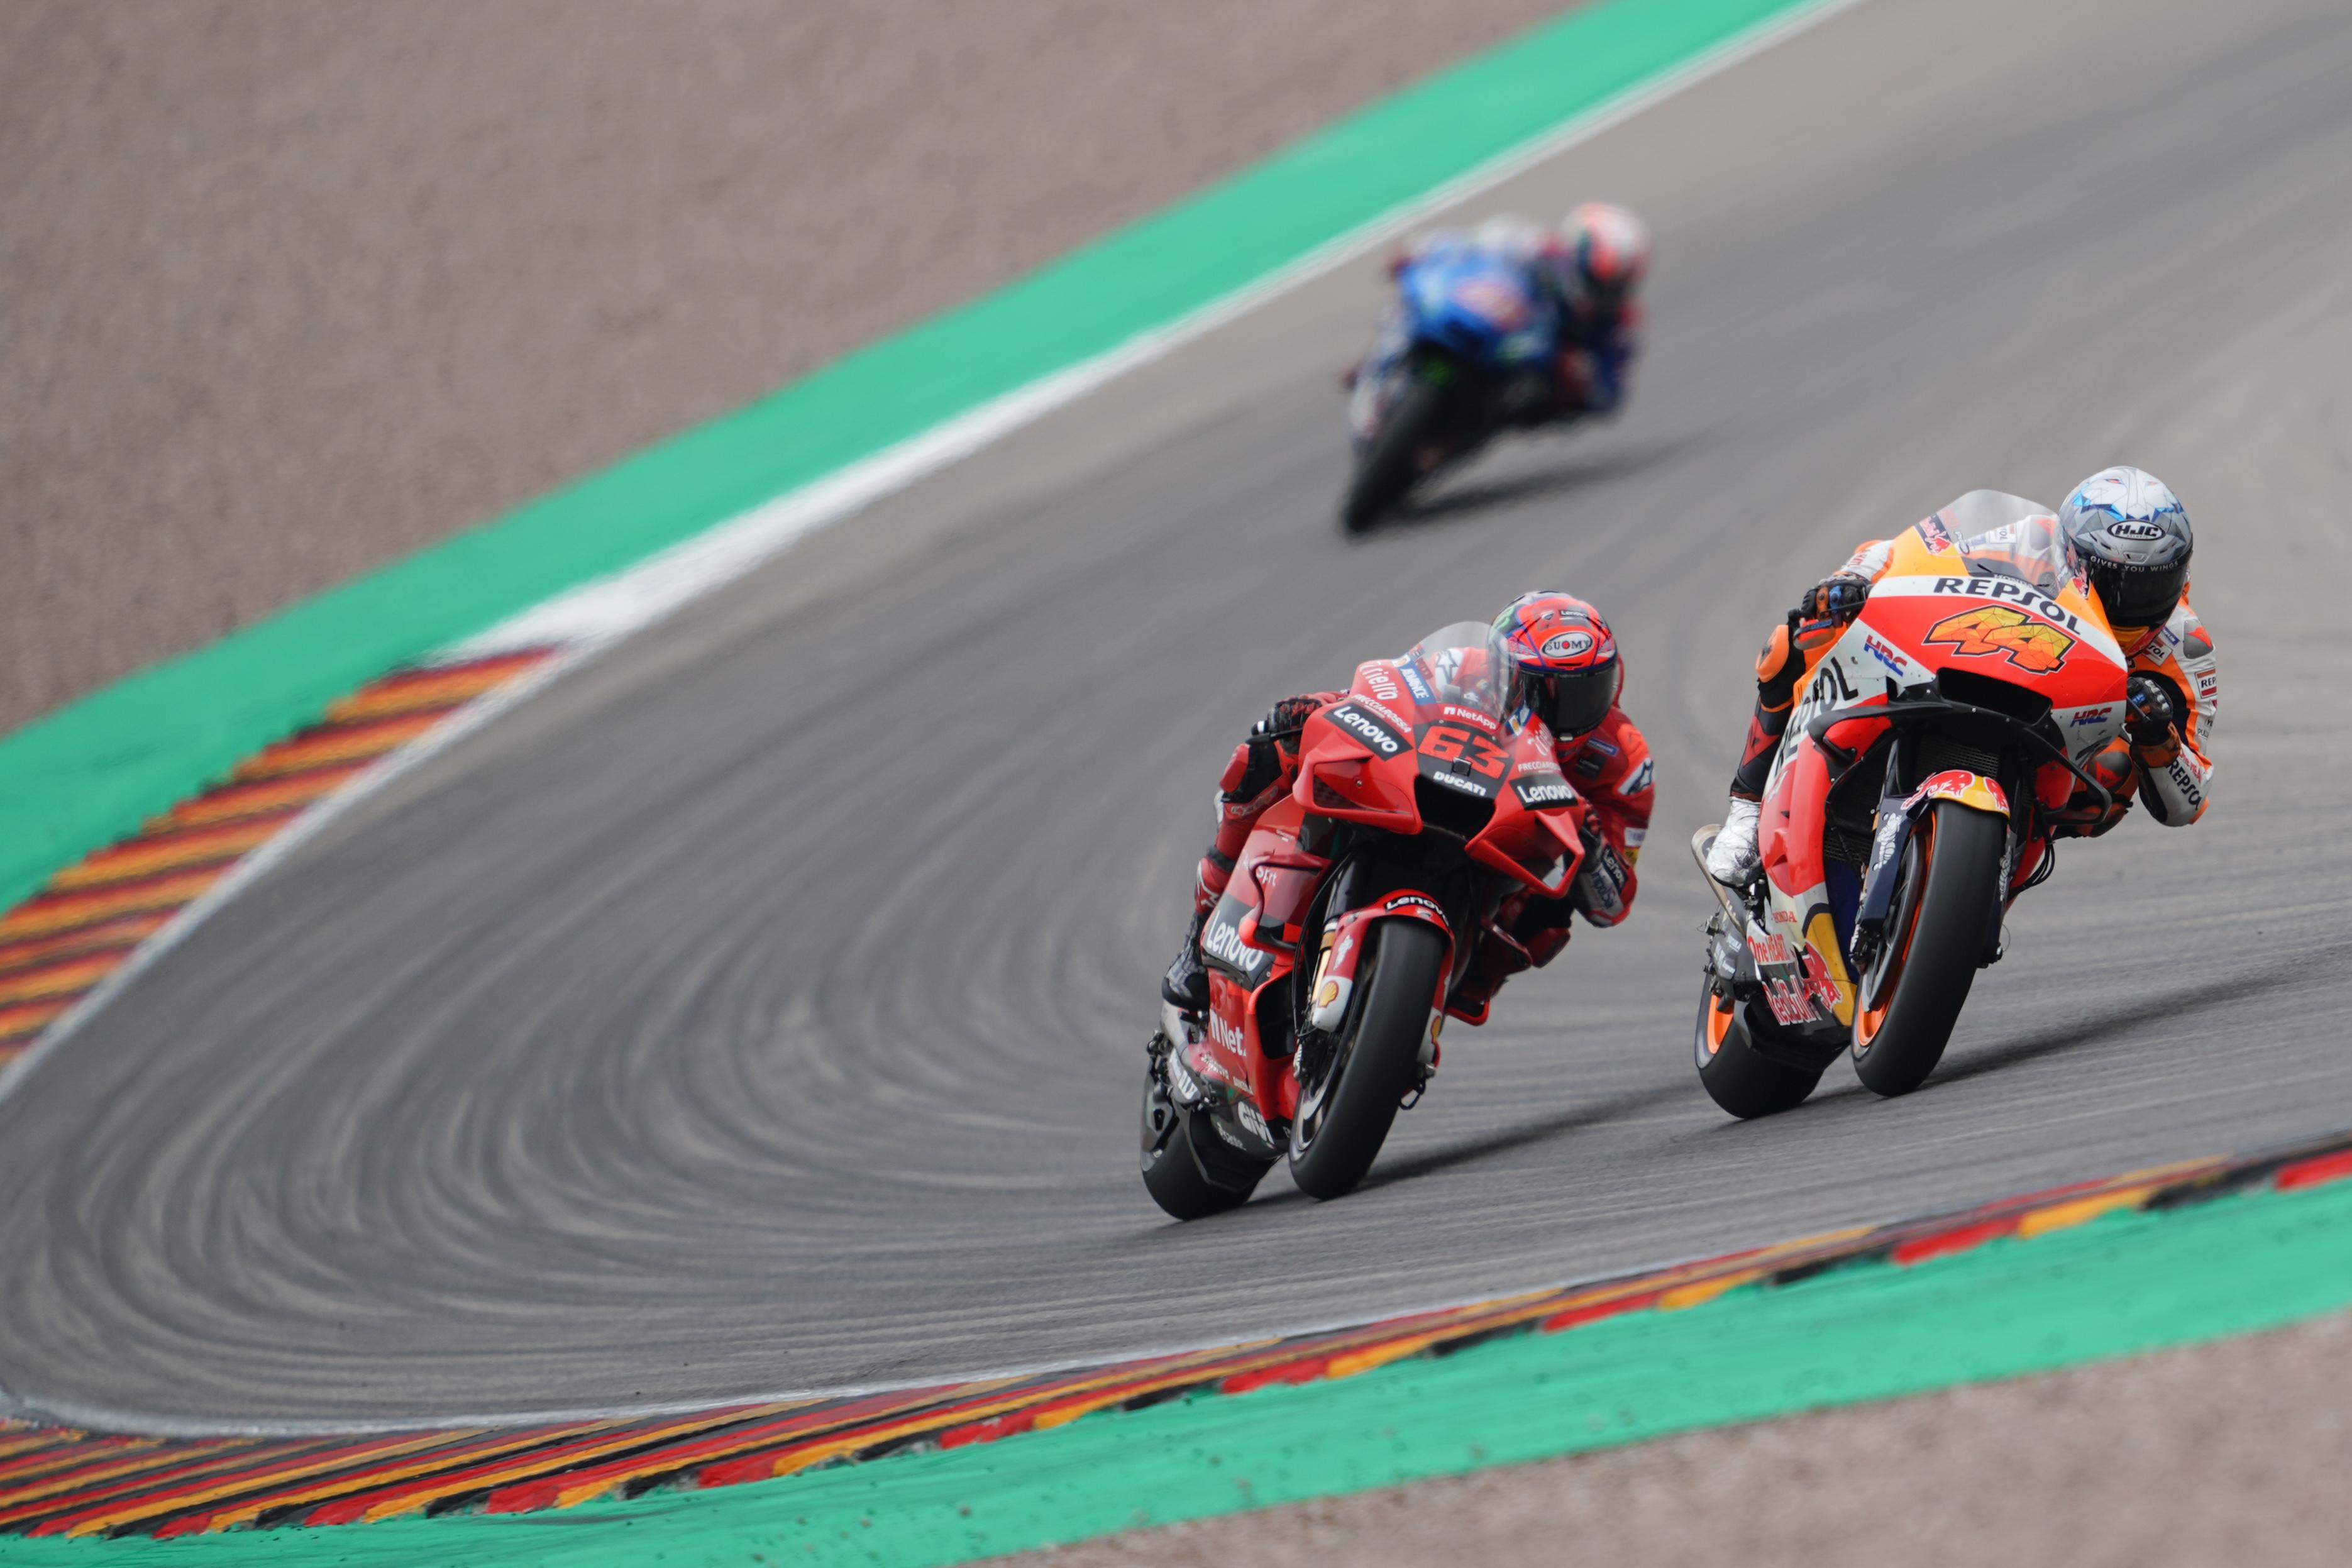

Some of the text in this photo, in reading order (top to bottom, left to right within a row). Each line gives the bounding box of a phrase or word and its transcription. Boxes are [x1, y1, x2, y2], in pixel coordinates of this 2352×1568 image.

[2115, 525, 2159, 536] HJC
[2090, 556, 2117, 569] GIVES
[2150, 561, 2178, 572] WINGS
[1933, 578, 2080, 635] REPSOL
[1545, 639, 1590, 651] SUOMY
[1924, 605, 2075, 673] 44
[2148, 645, 2166, 659] SOL
[1864, 634, 1908, 677] HRC
[2201, 676, 2216, 688] REP
[1333, 705, 1398, 753] Lenovo
[1457, 708, 1496, 730] NetApp
[1418, 726, 1510, 779] 63
[1433, 771, 1487, 797] DUCATI
[1517, 785, 1572, 803] Lenovo
[1206, 910, 1264, 971] Lenovo
[1748, 935, 1769, 963] One
[1219, 1017, 1244, 1056] Net
